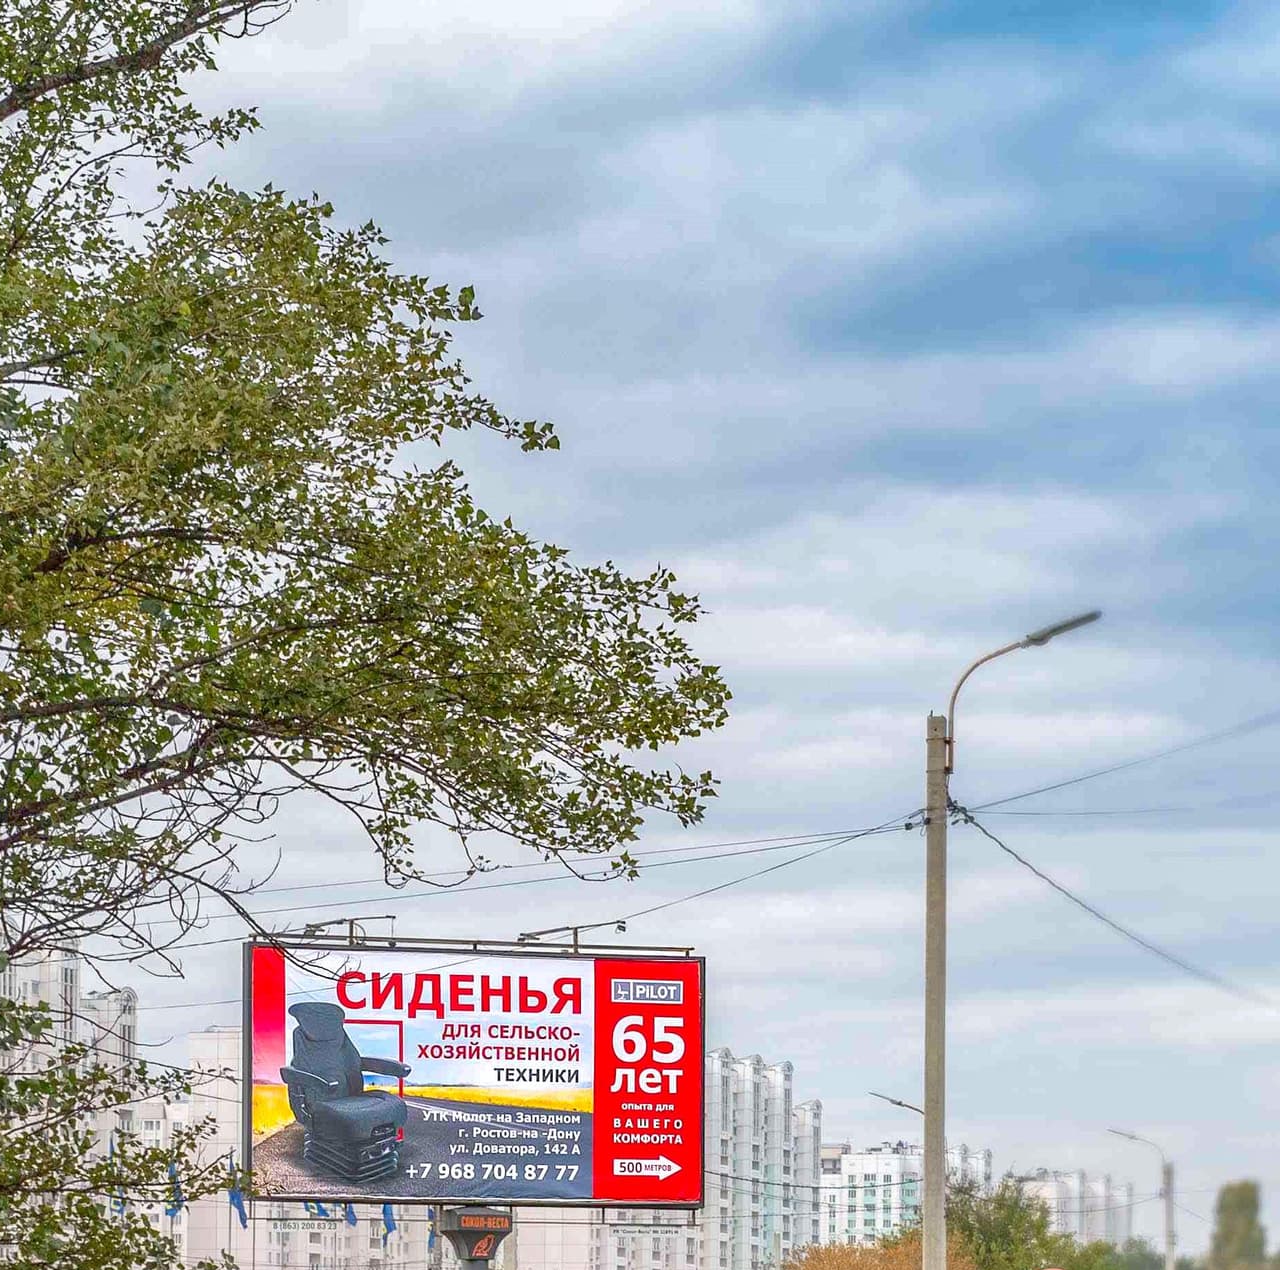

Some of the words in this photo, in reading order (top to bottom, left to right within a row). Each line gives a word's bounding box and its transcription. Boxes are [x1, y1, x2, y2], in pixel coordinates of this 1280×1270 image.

[336, 971, 582, 1019] СИДЕНЬЯ
[442, 1024, 481, 1040] ДЛЯ
[488, 1025, 580, 1040] СЕЛЬСКО-
[612, 1015, 686, 1064] 65
[417, 1041, 580, 1062] ХОЗЯЙСТВЕННОЙ
[494, 1067, 580, 1083] ТЕХНИКИ
[610, 1067, 684, 1094] лет
[621, 1103, 653, 1111] опыта
[655, 1103, 675, 1112] для
[422, 1110, 449, 1122] УТК
[452, 1110, 493, 1122] Молот
[496, 1115, 512, 1123] на
[516, 1112, 581, 1124] Западном
[613, 1118, 683, 1129] ВАШЕГО
[458, 1129, 469, 1138] г.
[613, 1132, 683, 1144] КОМФОРТА
[449, 1145, 469, 1156] ул.
[473, 1143, 539, 1156] Доватора,
[544, 1144, 568, 1155] 142
[571, 1144, 581, 1155] А
[406, 1164, 432, 1179] +7
[438, 1164, 475, 1180] 968
[481, 1164, 518, 1180] 704
[524, 1164, 548, 1181] 87
[555, 1165, 579, 1181] 77
[619, 1162, 642, 1173] 500
[644, 1164, 672, 1172] МЕТРОВ
